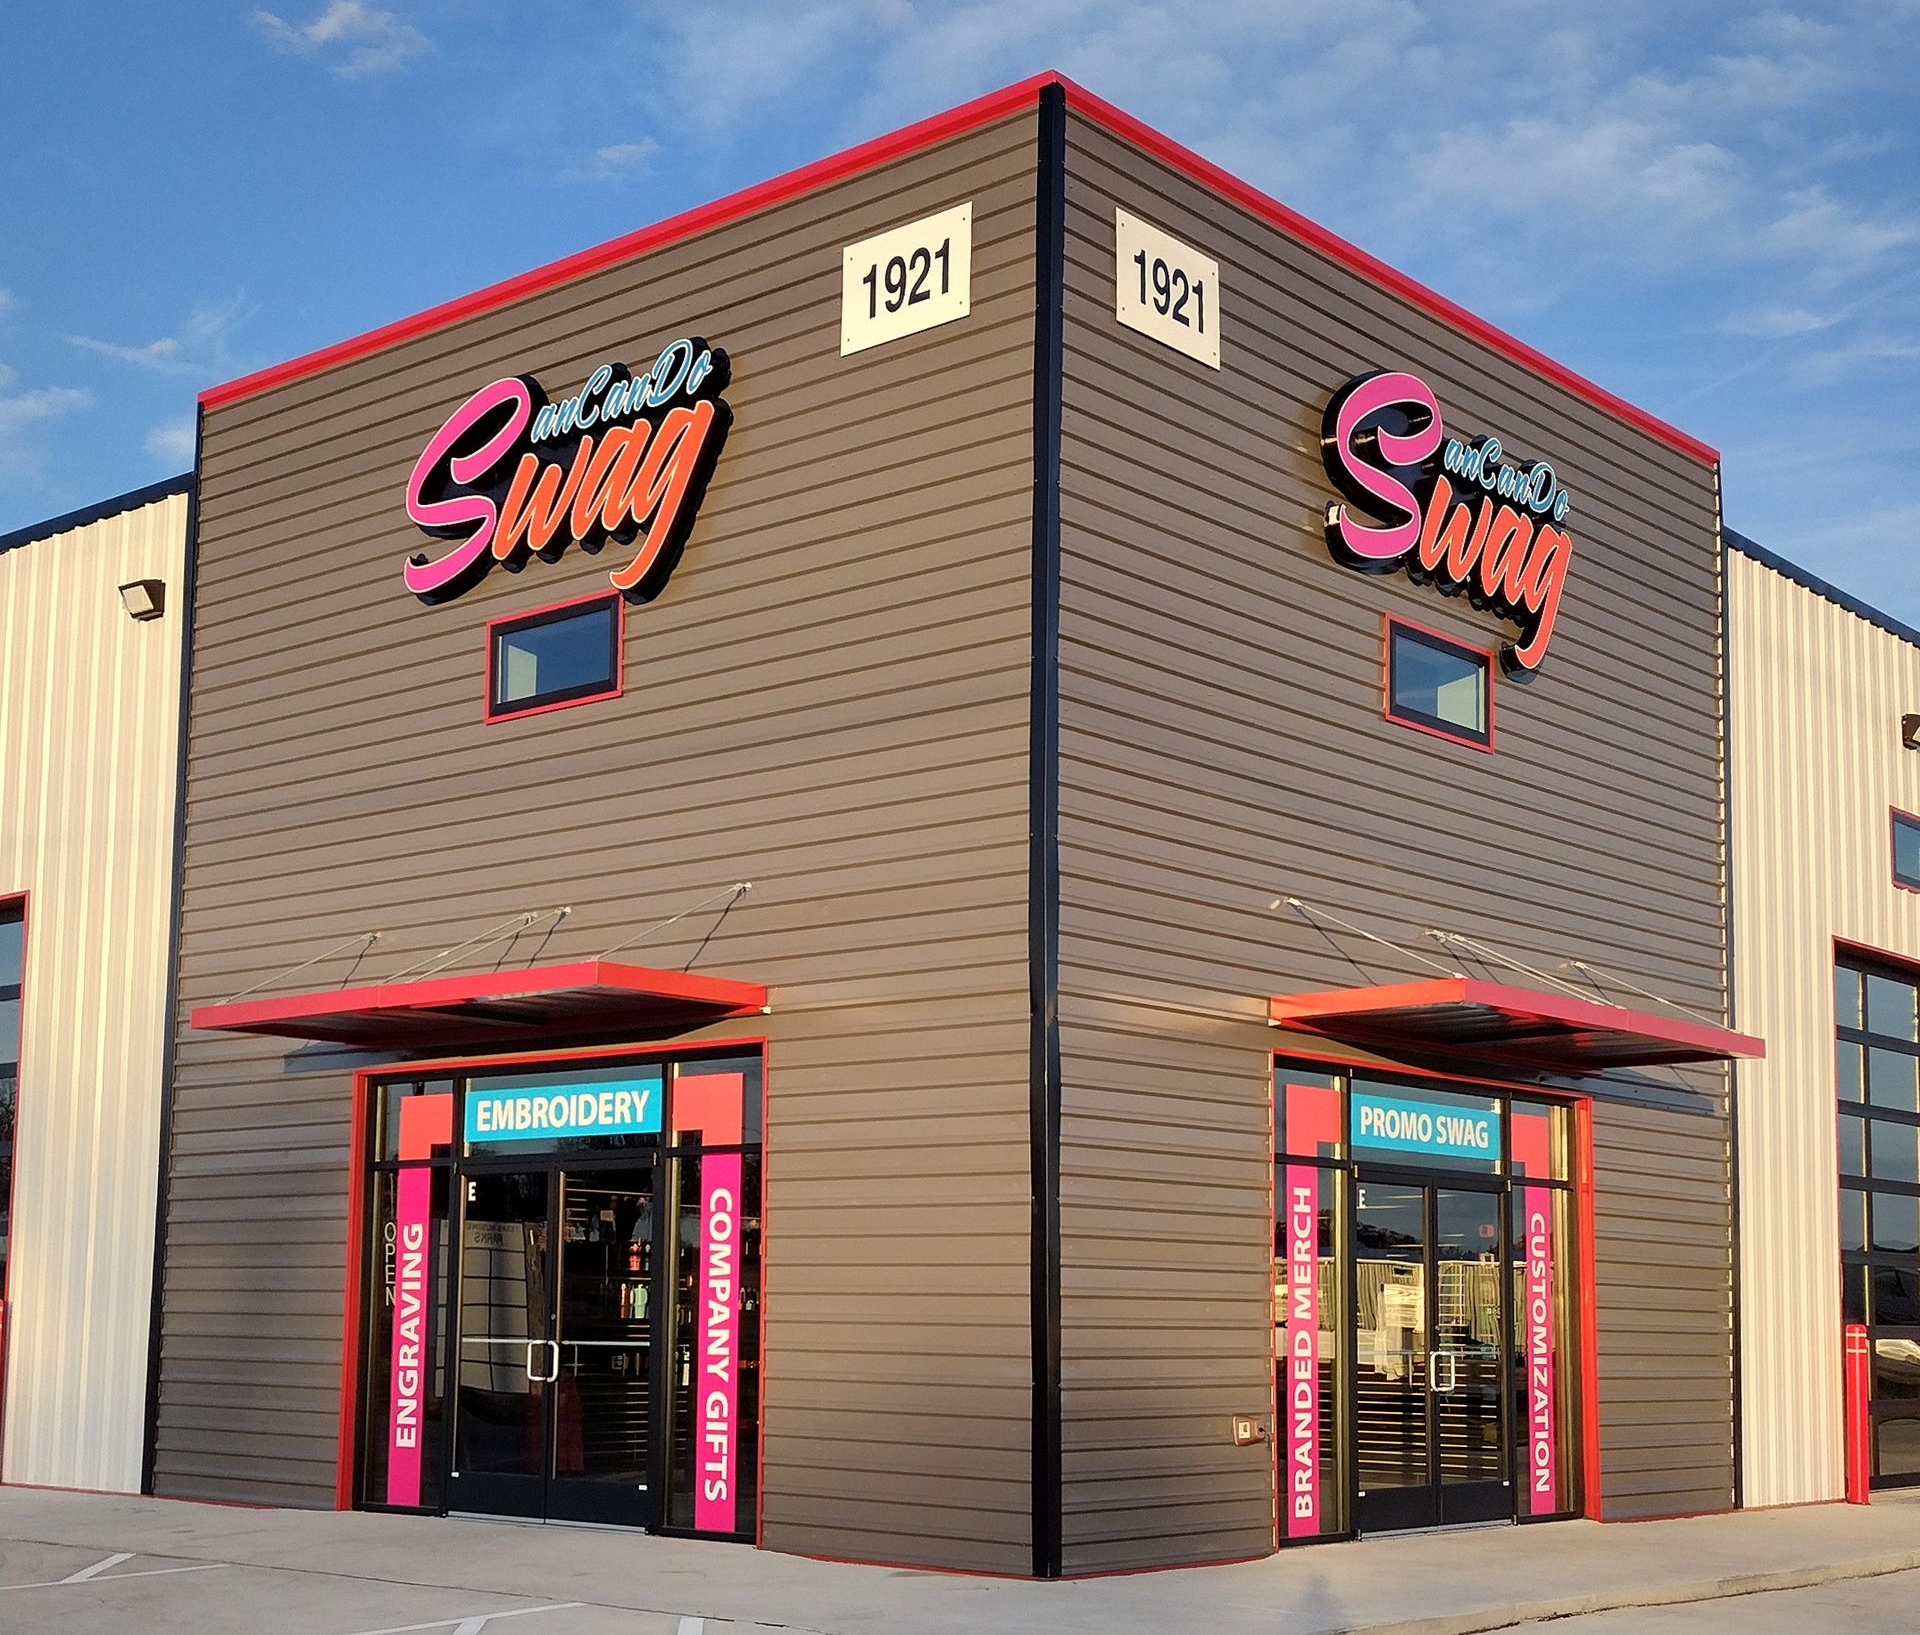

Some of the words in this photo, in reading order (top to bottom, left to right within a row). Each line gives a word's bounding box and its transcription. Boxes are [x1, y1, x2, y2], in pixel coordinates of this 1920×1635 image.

[863, 238, 950, 320] 1921
[1134, 249, 1204, 334] 1921
[404, 377, 714, 590] Swag
[1336, 372, 1573, 669] Swag
[476, 1090, 650, 1132] EMBROIDERY
[1360, 1105, 1432, 1141] PROMO
[1436, 1114, 1489, 1149] SWAG
[467, 1182, 477, 1201] E
[1358, 1189, 1367, 1209] E
[384, 1221, 397, 1307] OPEN
[706, 1187, 732, 1383] COMPANY
[1293, 1187, 1312, 1320] MERCH
[395, 1222, 424, 1449] ENGRAVING
[1530, 1212, 1550, 1493] CUSTOMIZATION
[704, 1391, 729, 1502] GIFTS
[1294, 1329, 1313, 1518] BRANDED
